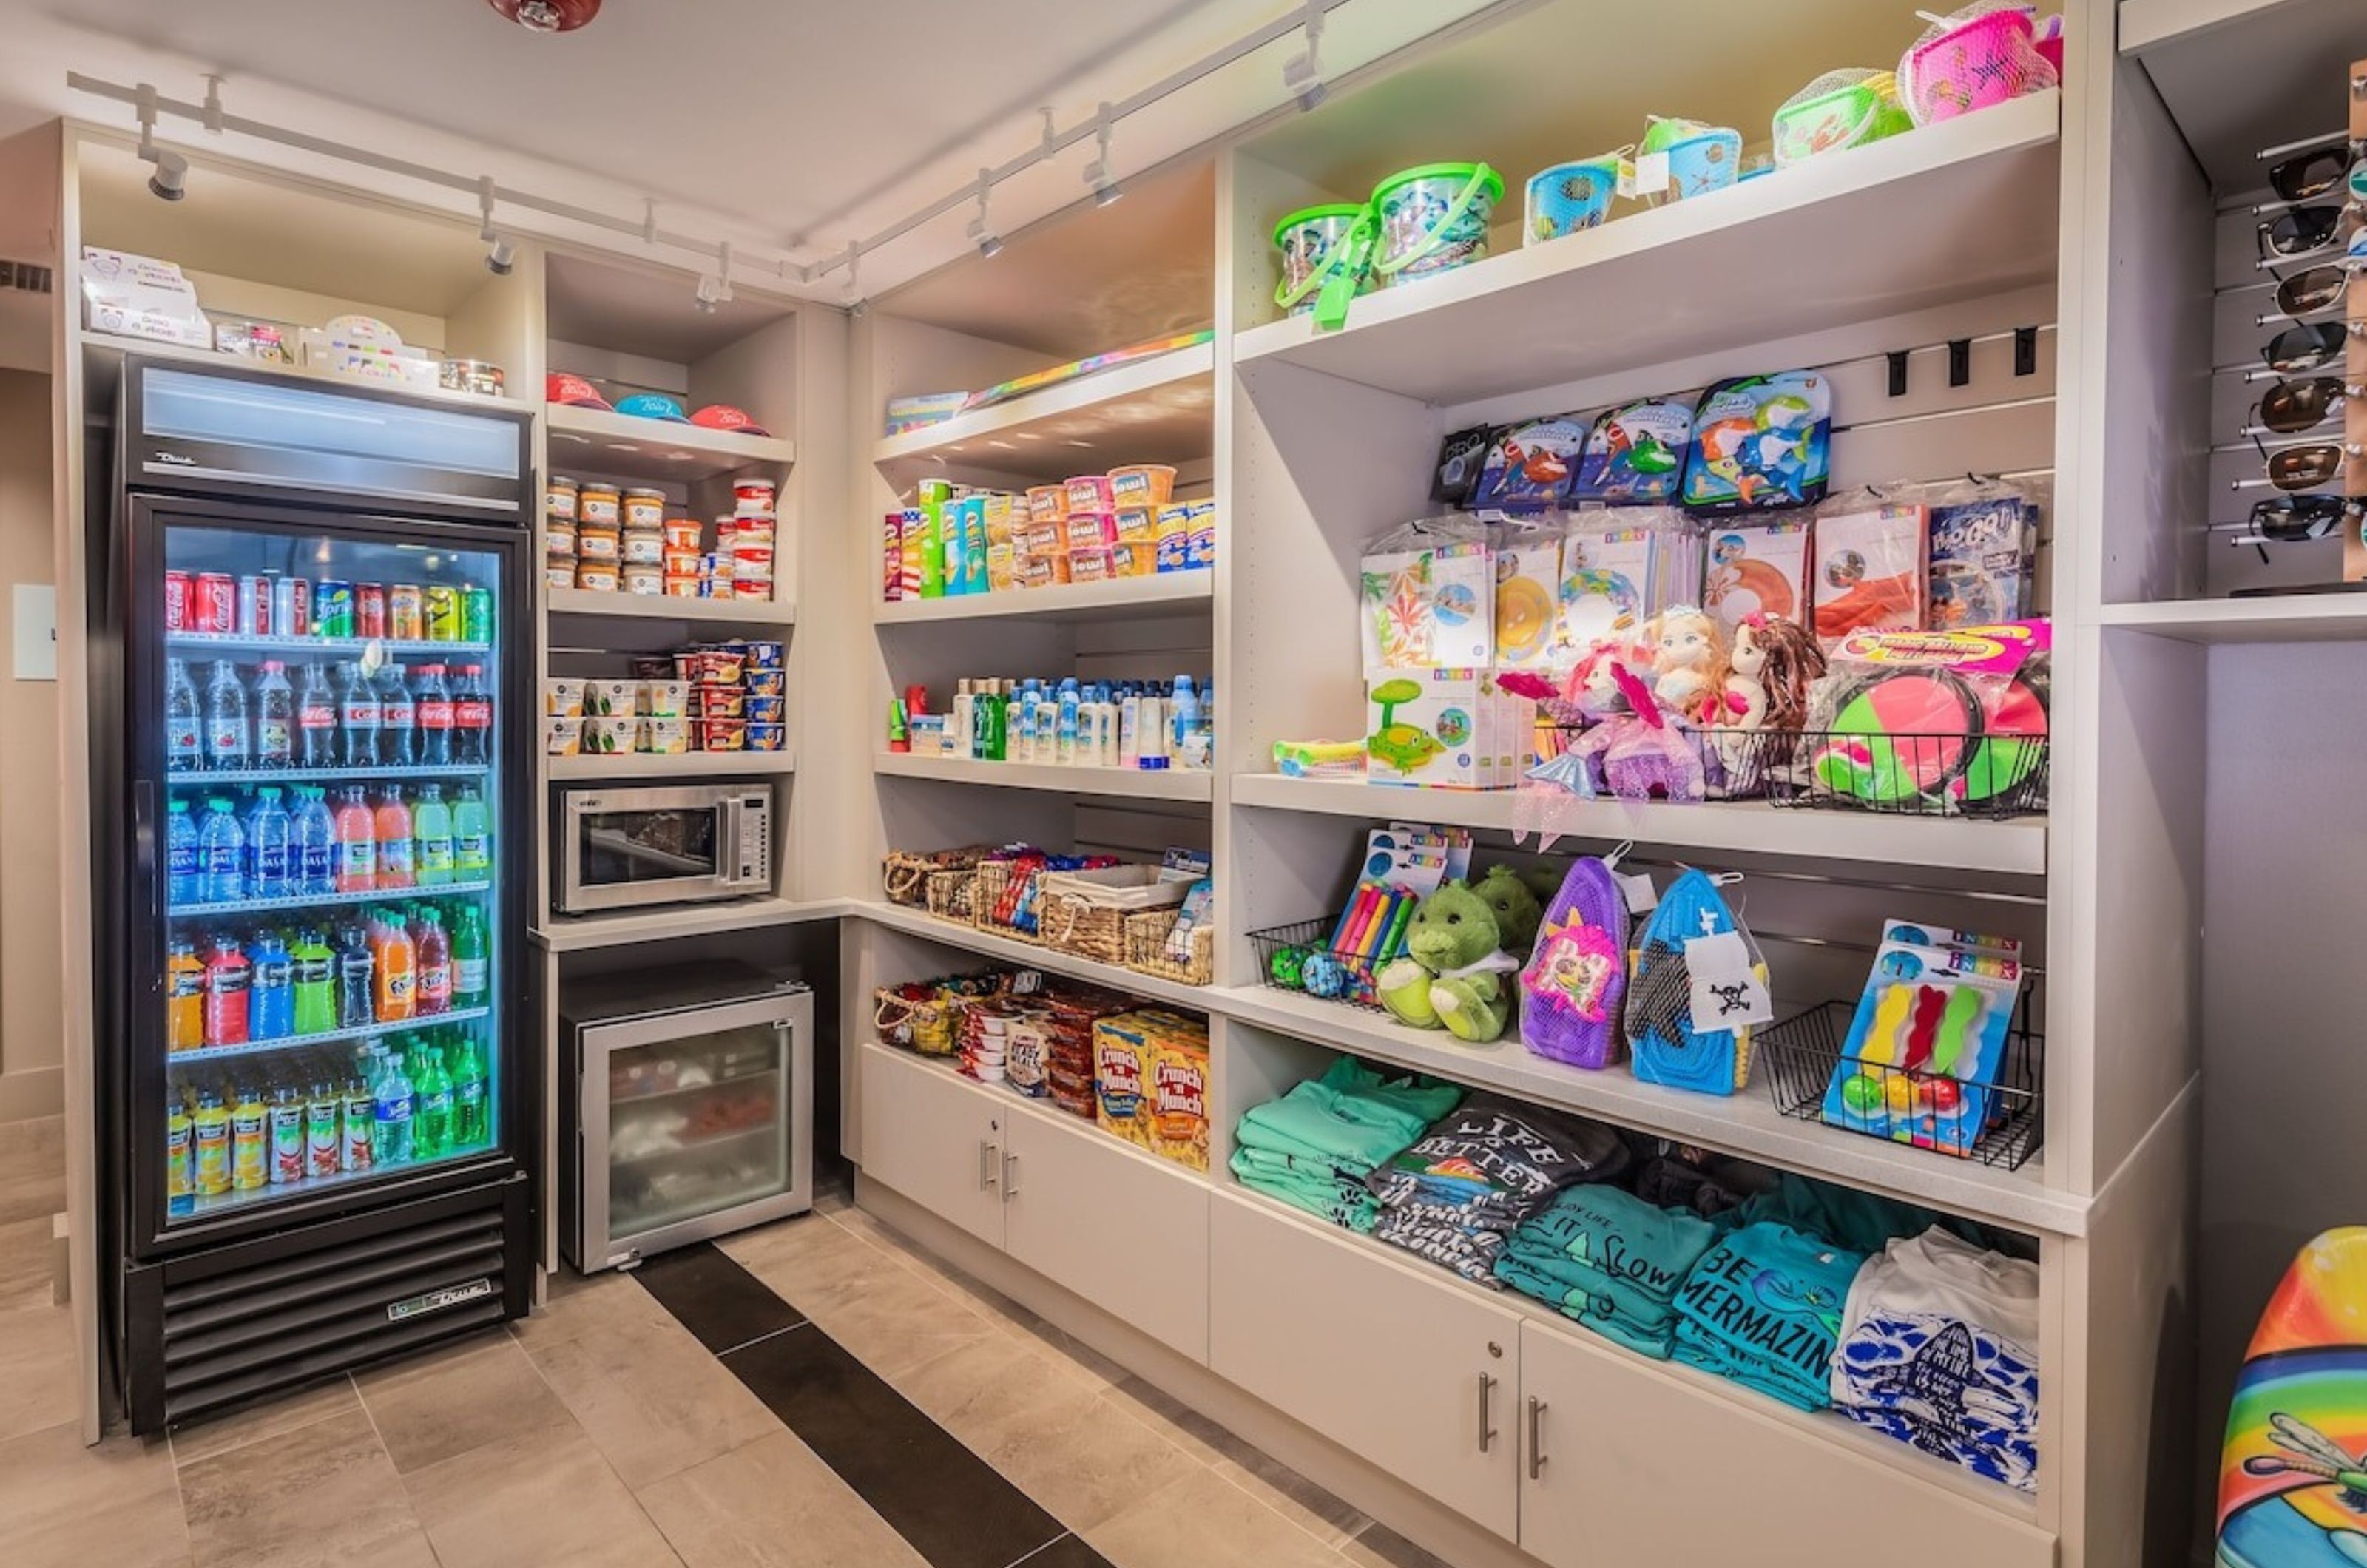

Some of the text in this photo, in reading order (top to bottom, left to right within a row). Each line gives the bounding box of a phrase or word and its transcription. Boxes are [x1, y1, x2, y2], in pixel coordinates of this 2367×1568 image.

[1098, 1043, 1140, 1073] Crunch
[1101, 1067, 1141, 1096] Munch
[1155, 1061, 1203, 1094] Crunch
[1157, 1088, 1203, 1118] Munch
[1457, 1118, 1564, 1164] LIFE
[1411, 1137, 1546, 1196] BETTER
[1704, 1248, 1759, 1285] BE
[1683, 1280, 1831, 1380] MERMAZIN
